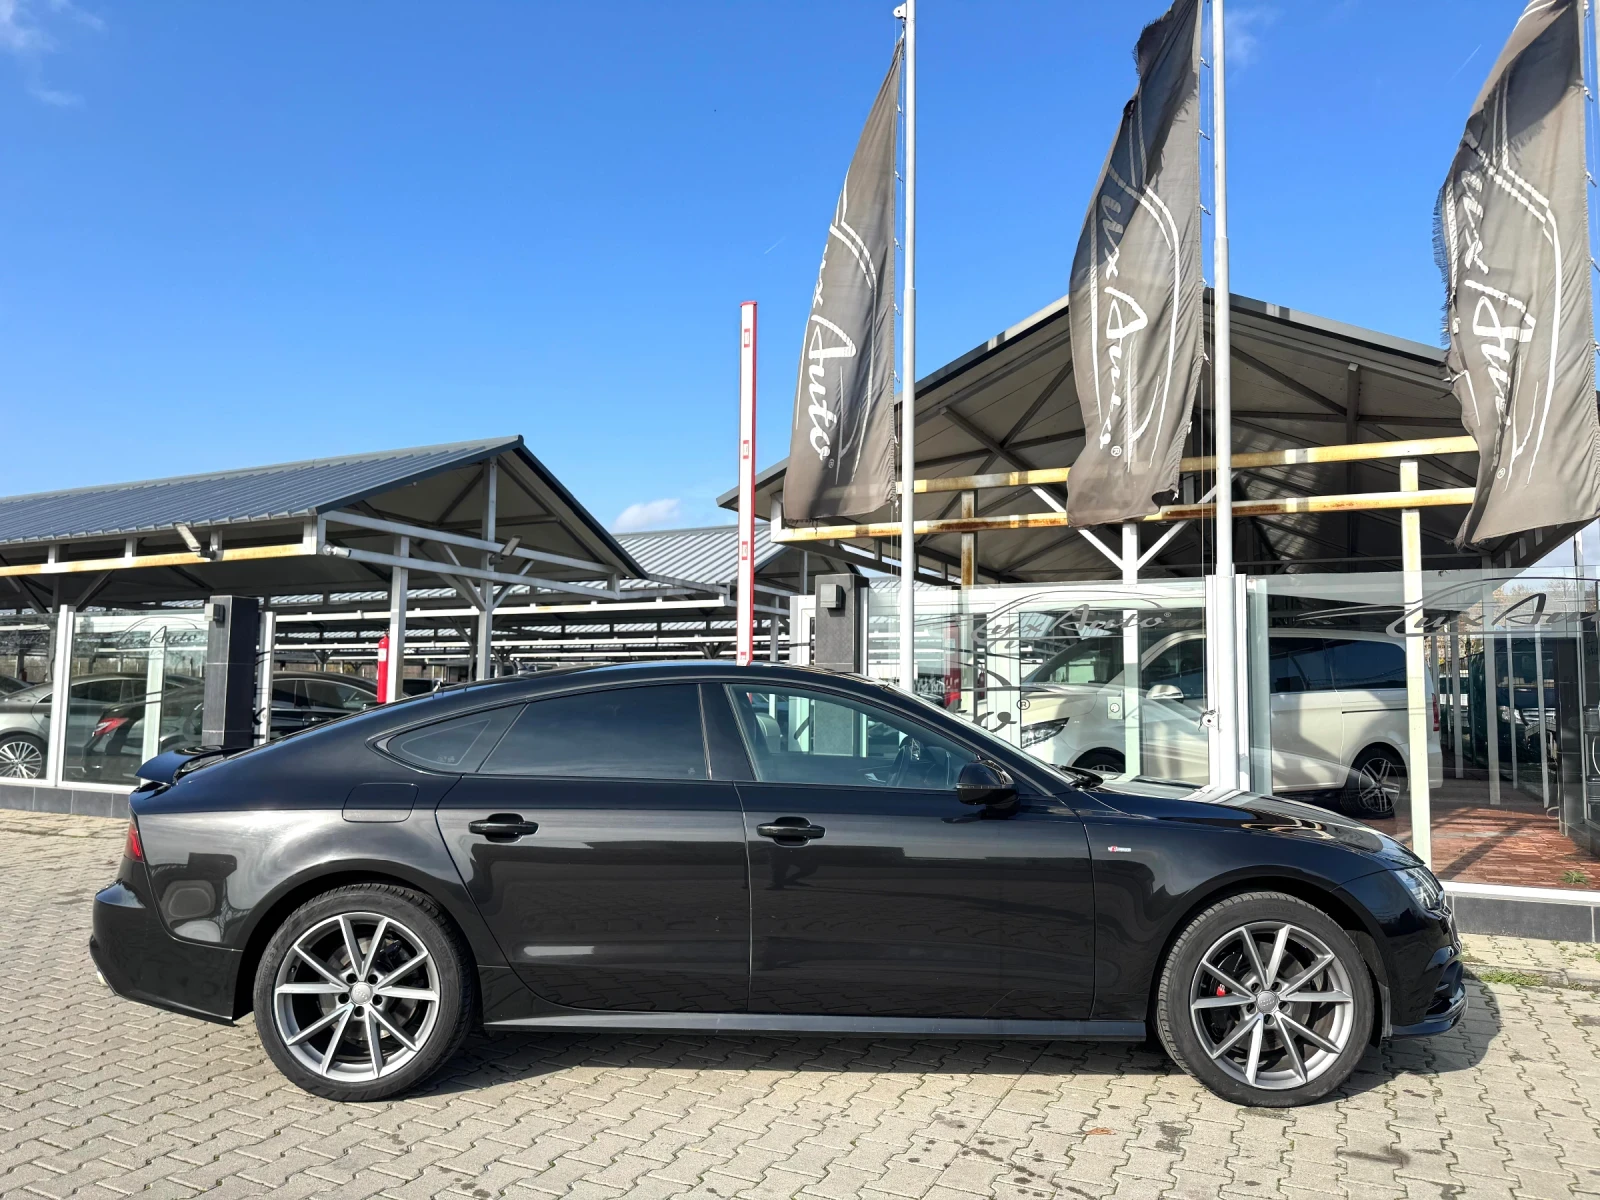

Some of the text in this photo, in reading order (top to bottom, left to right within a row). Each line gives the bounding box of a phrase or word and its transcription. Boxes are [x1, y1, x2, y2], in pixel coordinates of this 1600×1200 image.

[808, 314, 857, 461] Auto
[1048, 603, 1165, 632] Auto
[149, 625, 197, 644] Auto
